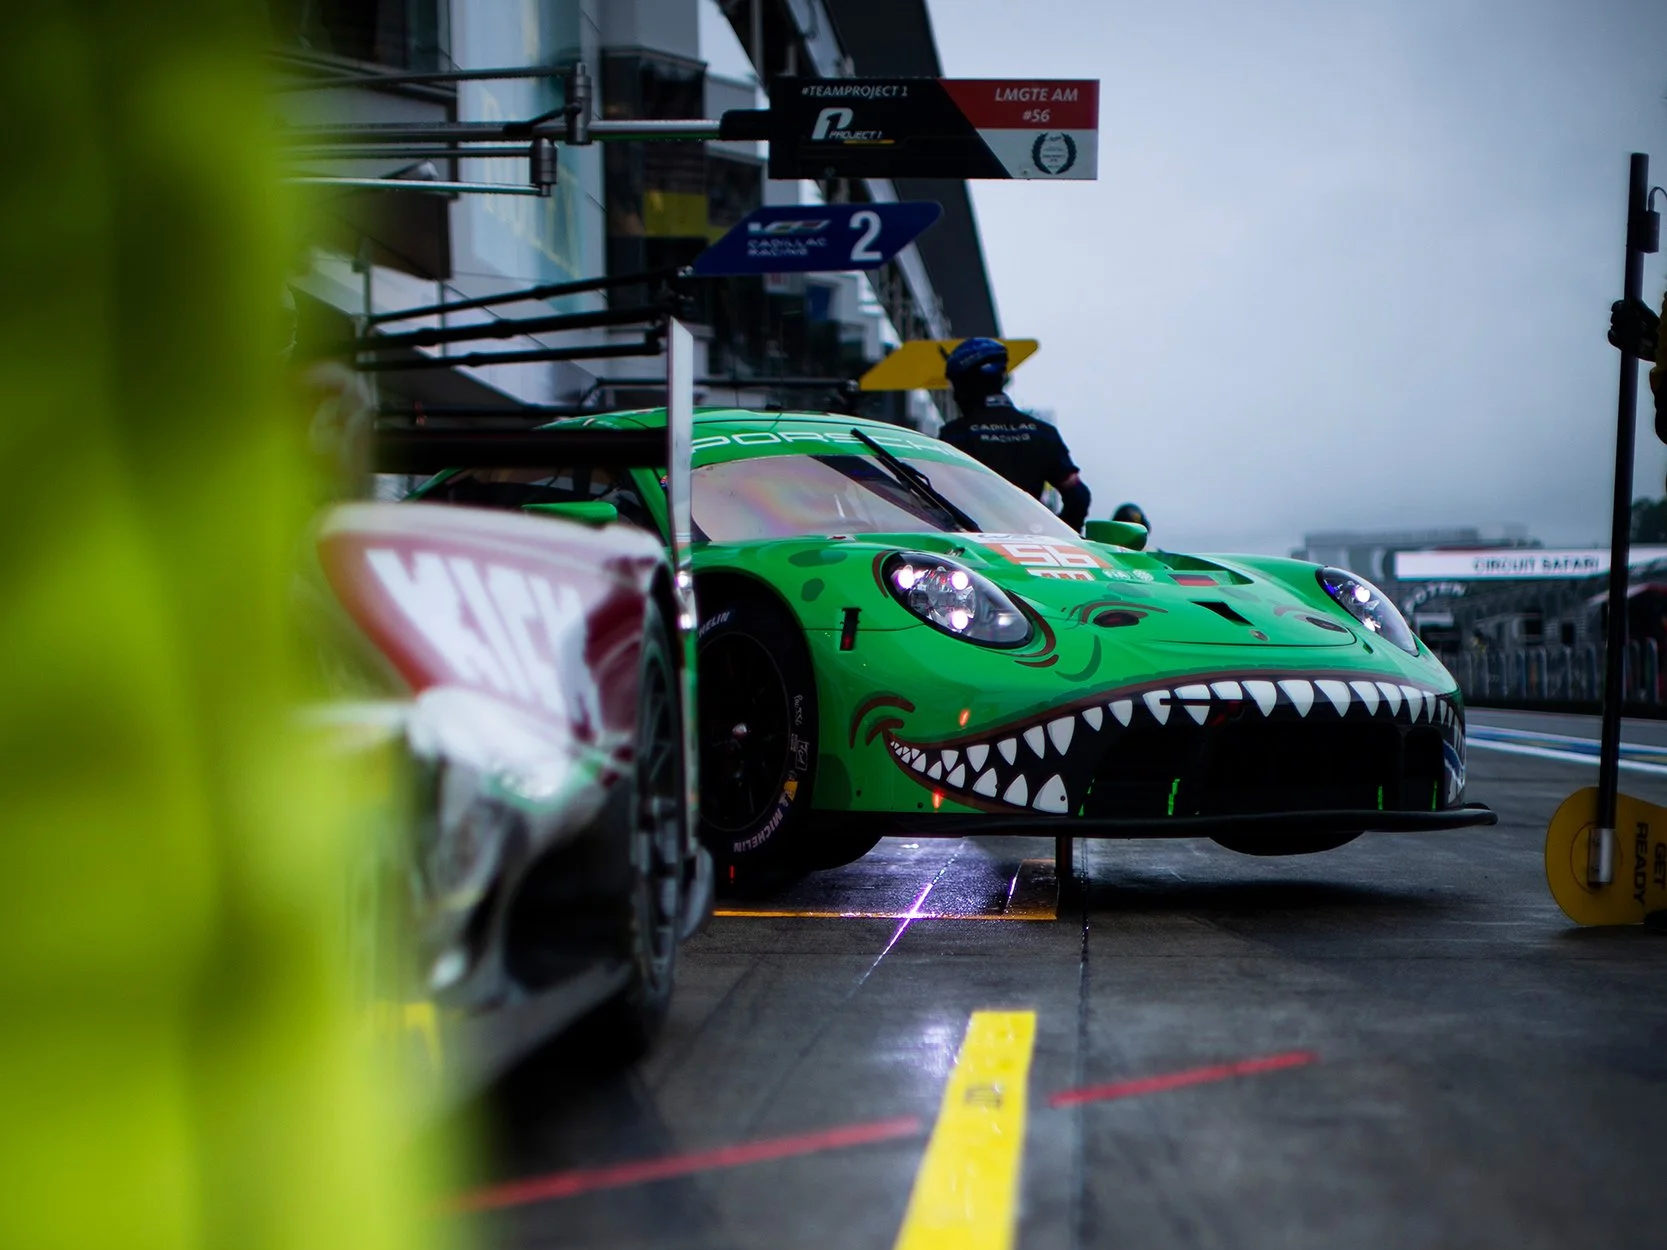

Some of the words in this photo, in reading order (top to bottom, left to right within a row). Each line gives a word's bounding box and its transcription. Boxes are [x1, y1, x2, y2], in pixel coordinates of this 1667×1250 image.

[802, 85, 899, 99] #TEAMPROJECT
[900, 86, 908, 97] 1
[995, 87, 1049, 101] LMGTE
[1051, 87, 1079, 101] AM
[1022, 109, 1051, 122] #56
[829, 130, 877, 140] PROJECT
[747, 237, 827, 248] CADILLAC
[849, 210, 882, 261] 2
[747, 248, 808, 257] RACING
[970, 423, 1037, 432] CADILLAC
[980, 432, 1031, 442] RACING
[691, 431, 958, 458] PORSCH
[1001, 544, 1100, 568] 56
[1474, 556, 1536, 572] CIRCUIT
[1542, 556, 1600, 572] SAFARI
[732, 807, 784, 852] MICHELIN
[1632, 821, 1649, 906] READY
[1653, 841, 1667, 891] GET
